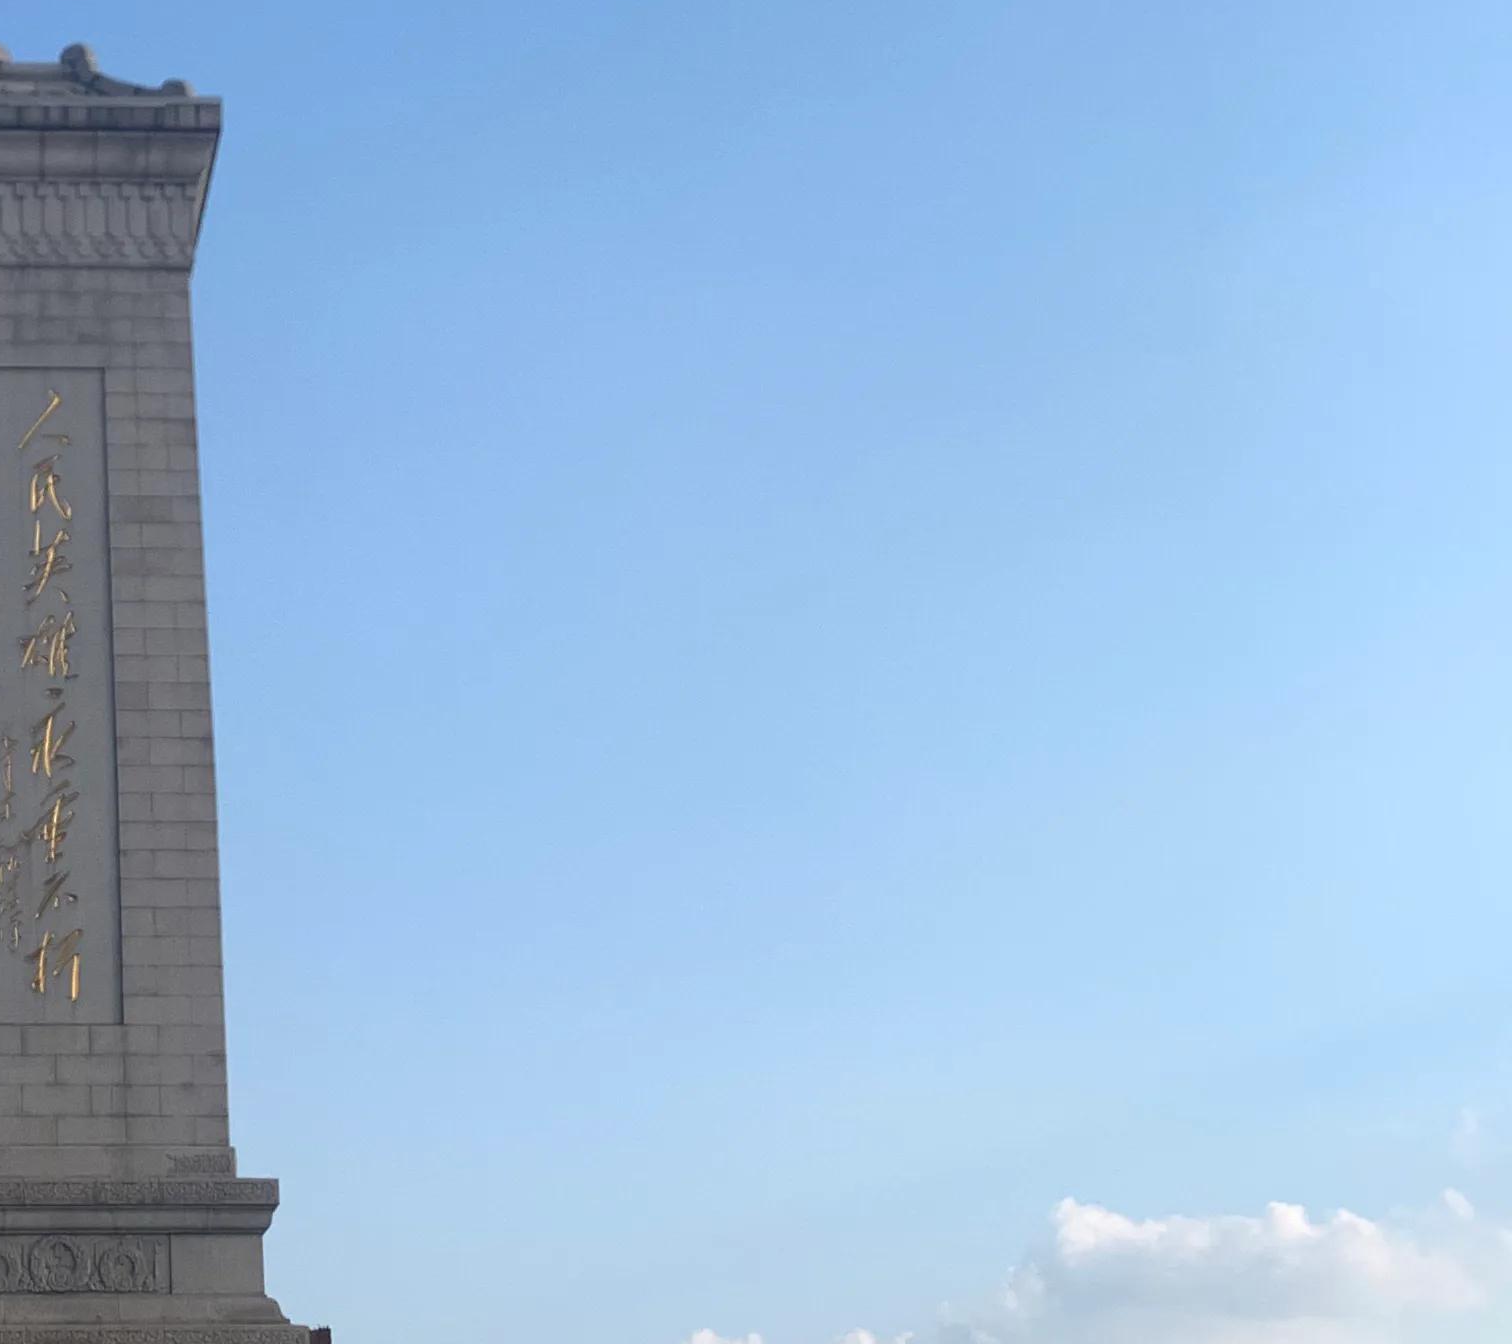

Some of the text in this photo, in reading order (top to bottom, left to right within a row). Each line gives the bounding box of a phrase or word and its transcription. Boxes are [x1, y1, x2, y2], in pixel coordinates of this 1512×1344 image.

[17, 389, 82, 1002] 人民英雄永垂不朽
